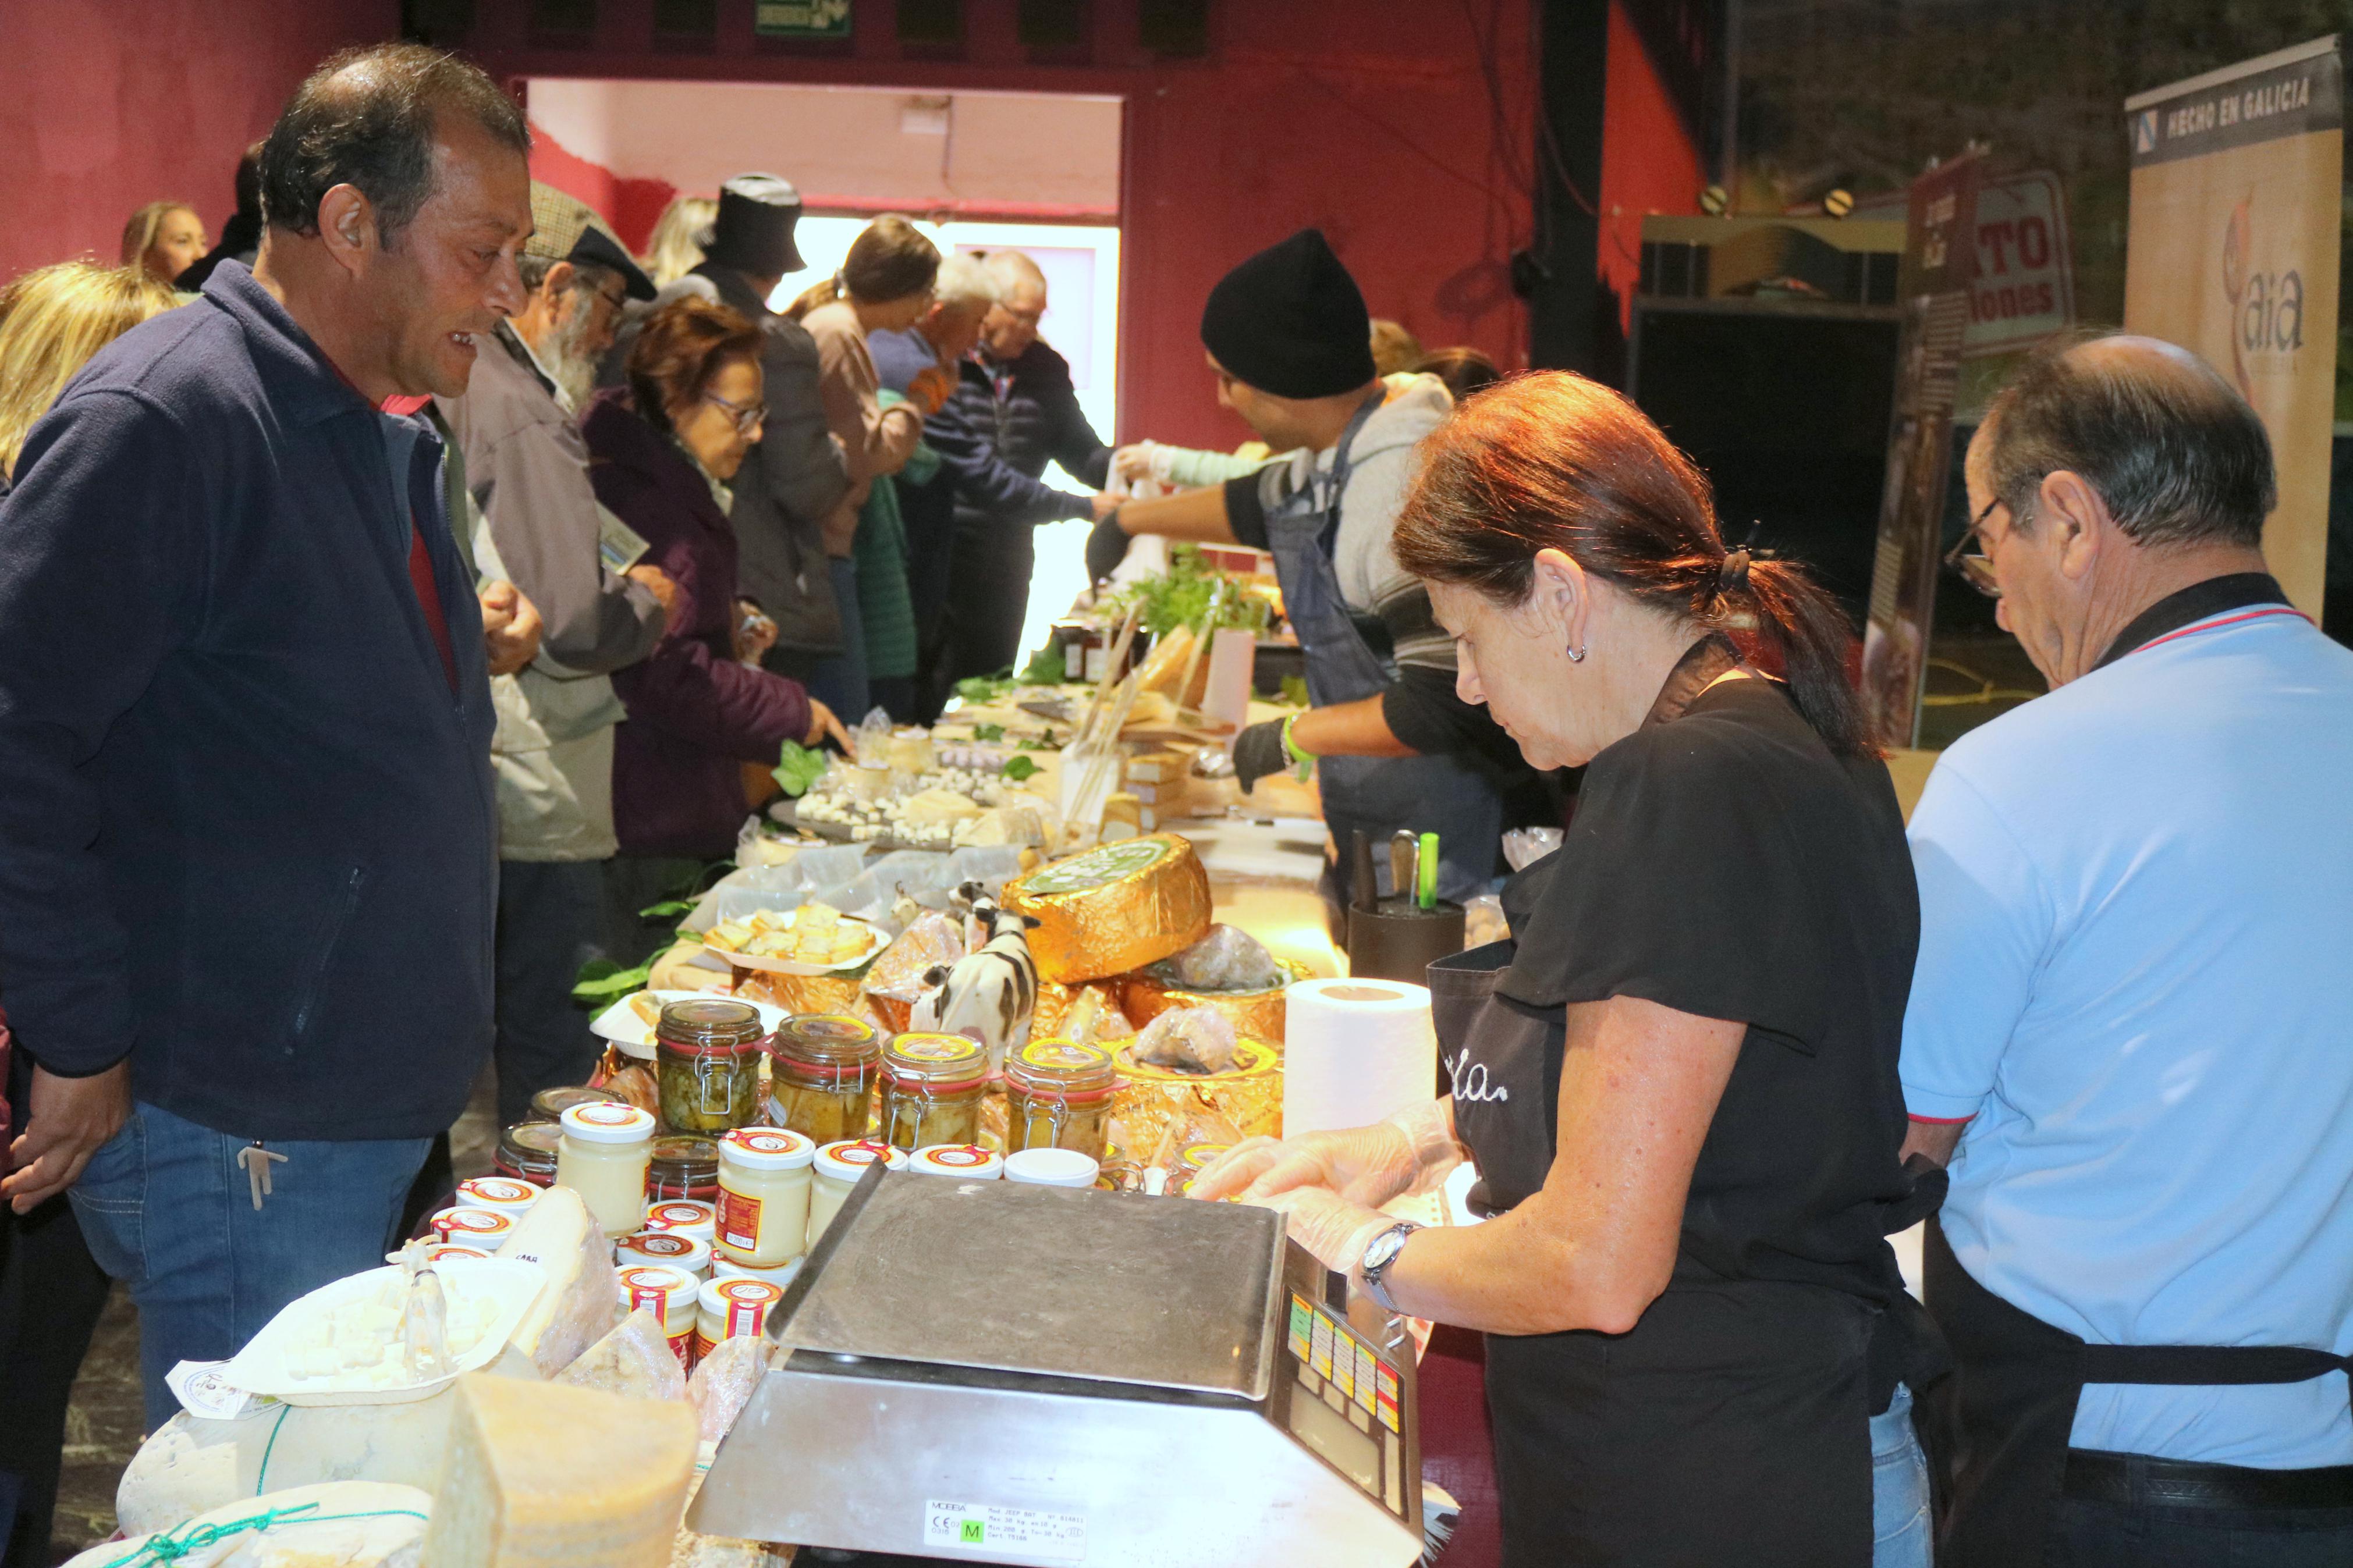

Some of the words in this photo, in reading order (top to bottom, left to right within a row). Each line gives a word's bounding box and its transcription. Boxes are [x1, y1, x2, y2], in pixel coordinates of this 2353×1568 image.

[2167, 102, 2215, 138] HECHO
[2220, 95, 2240, 126] EN
[2244, 77, 2310, 120] GALICIA
[965, 1524, 979, 1538] M
